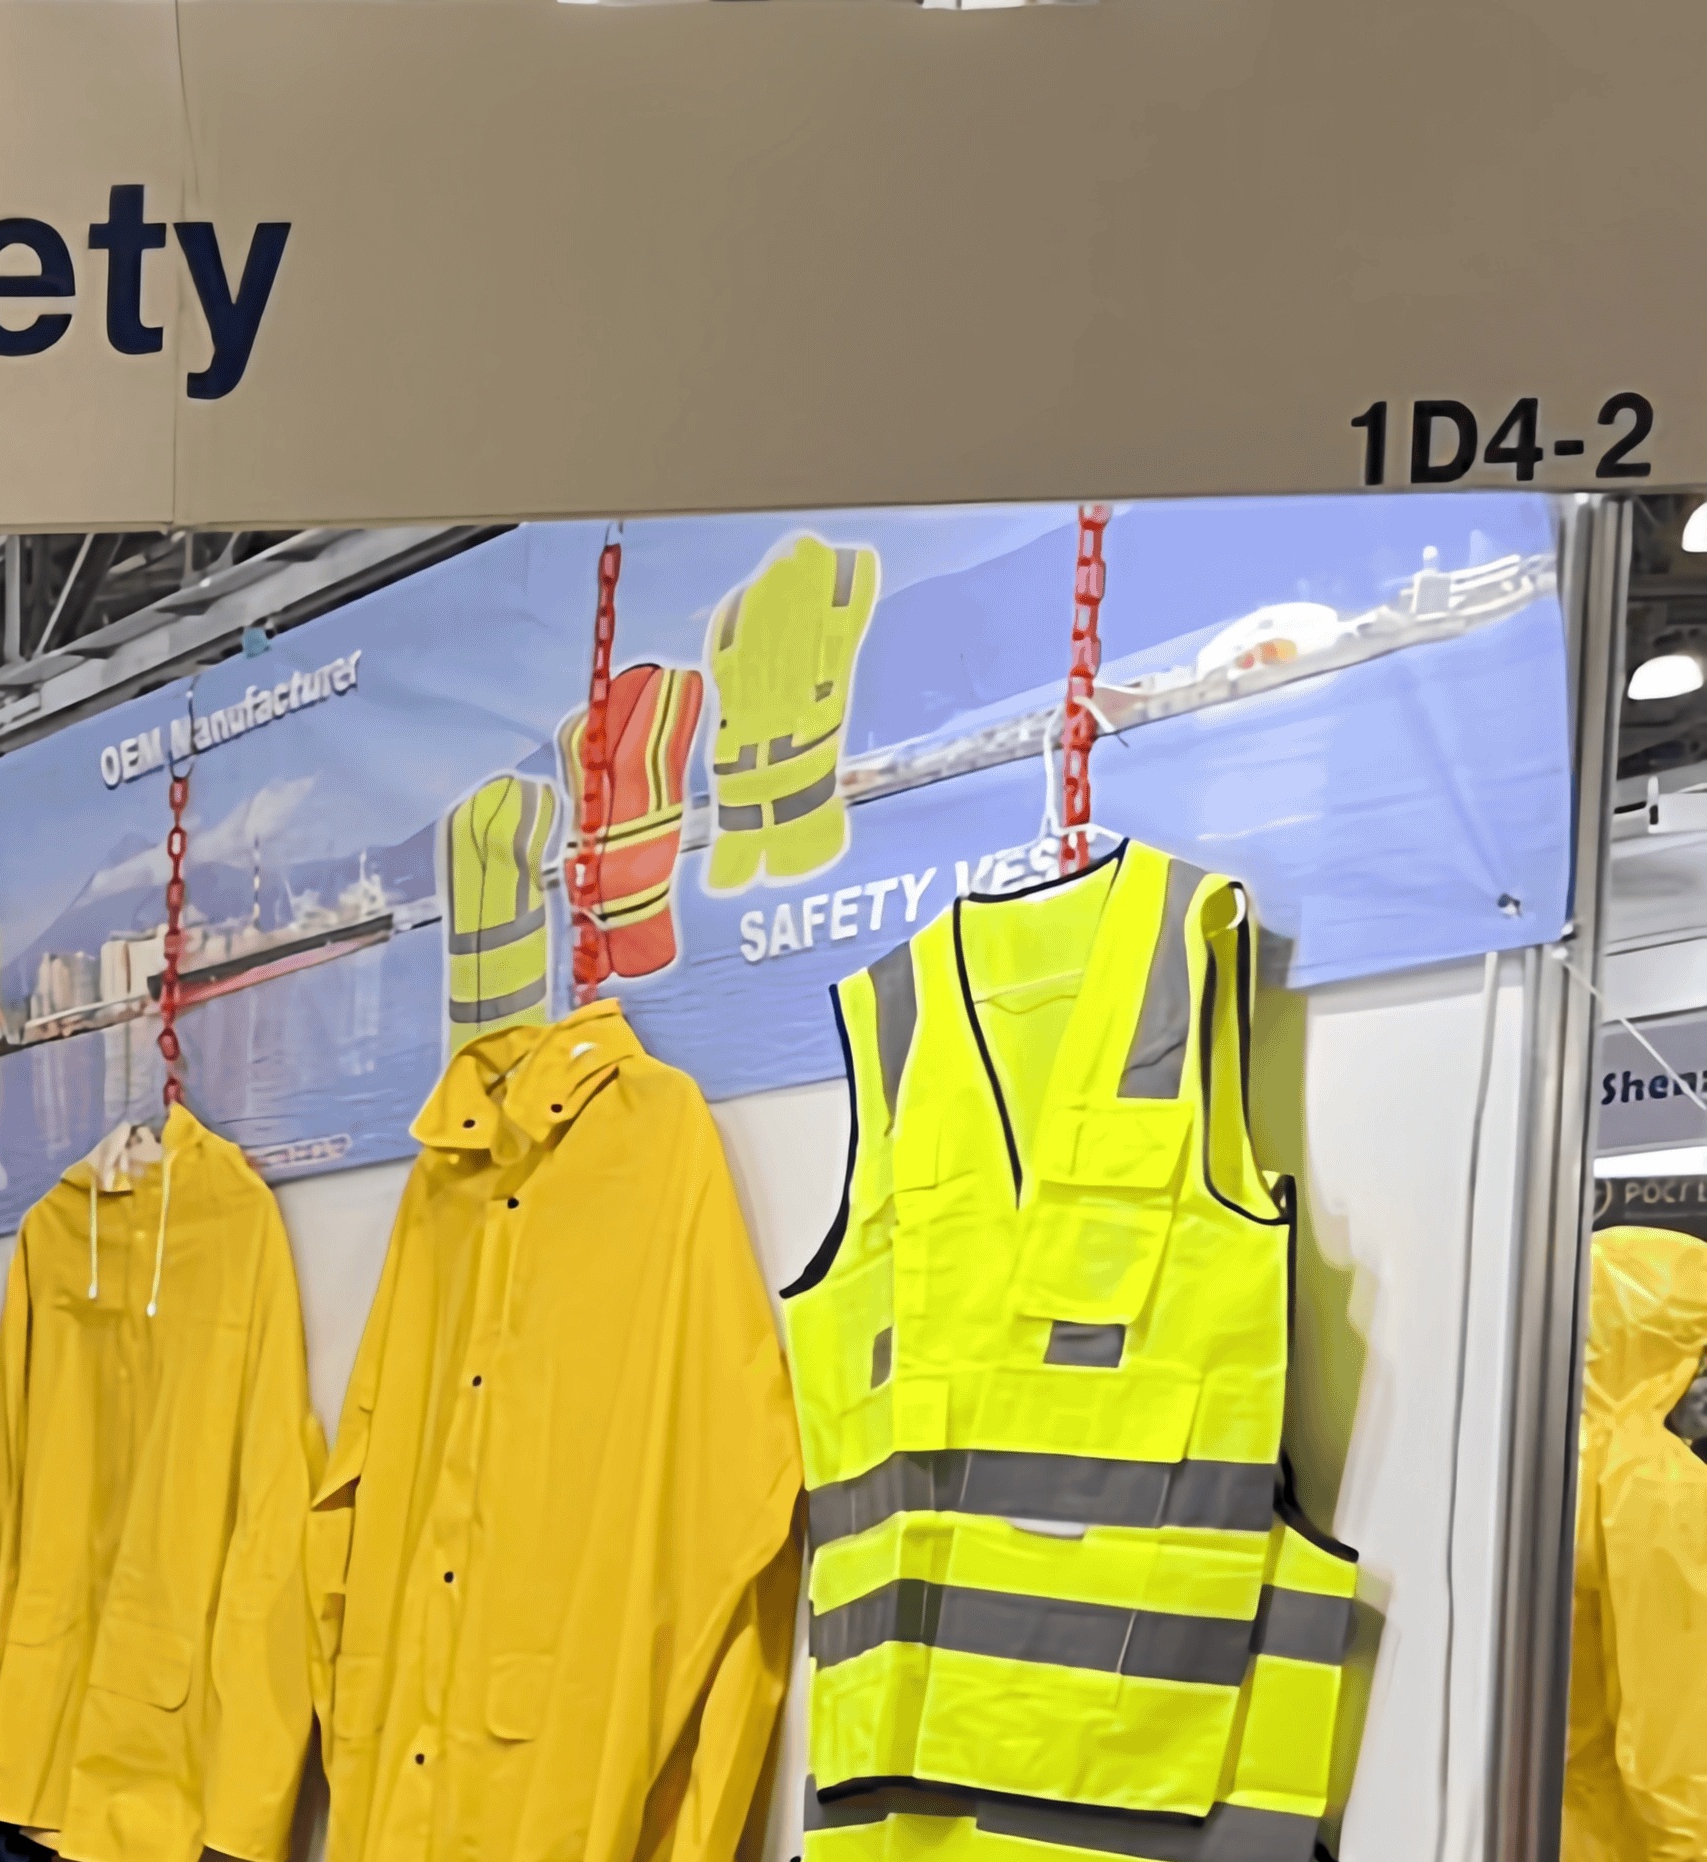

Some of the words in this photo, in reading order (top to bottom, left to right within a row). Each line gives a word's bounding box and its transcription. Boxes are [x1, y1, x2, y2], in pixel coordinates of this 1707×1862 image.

[1350, 391, 1654, 486] 1D4-2
[100, 727, 165, 786] OEM
[170, 649, 362, 762] Manufacturer
[739, 868, 937, 962] SAFETY
